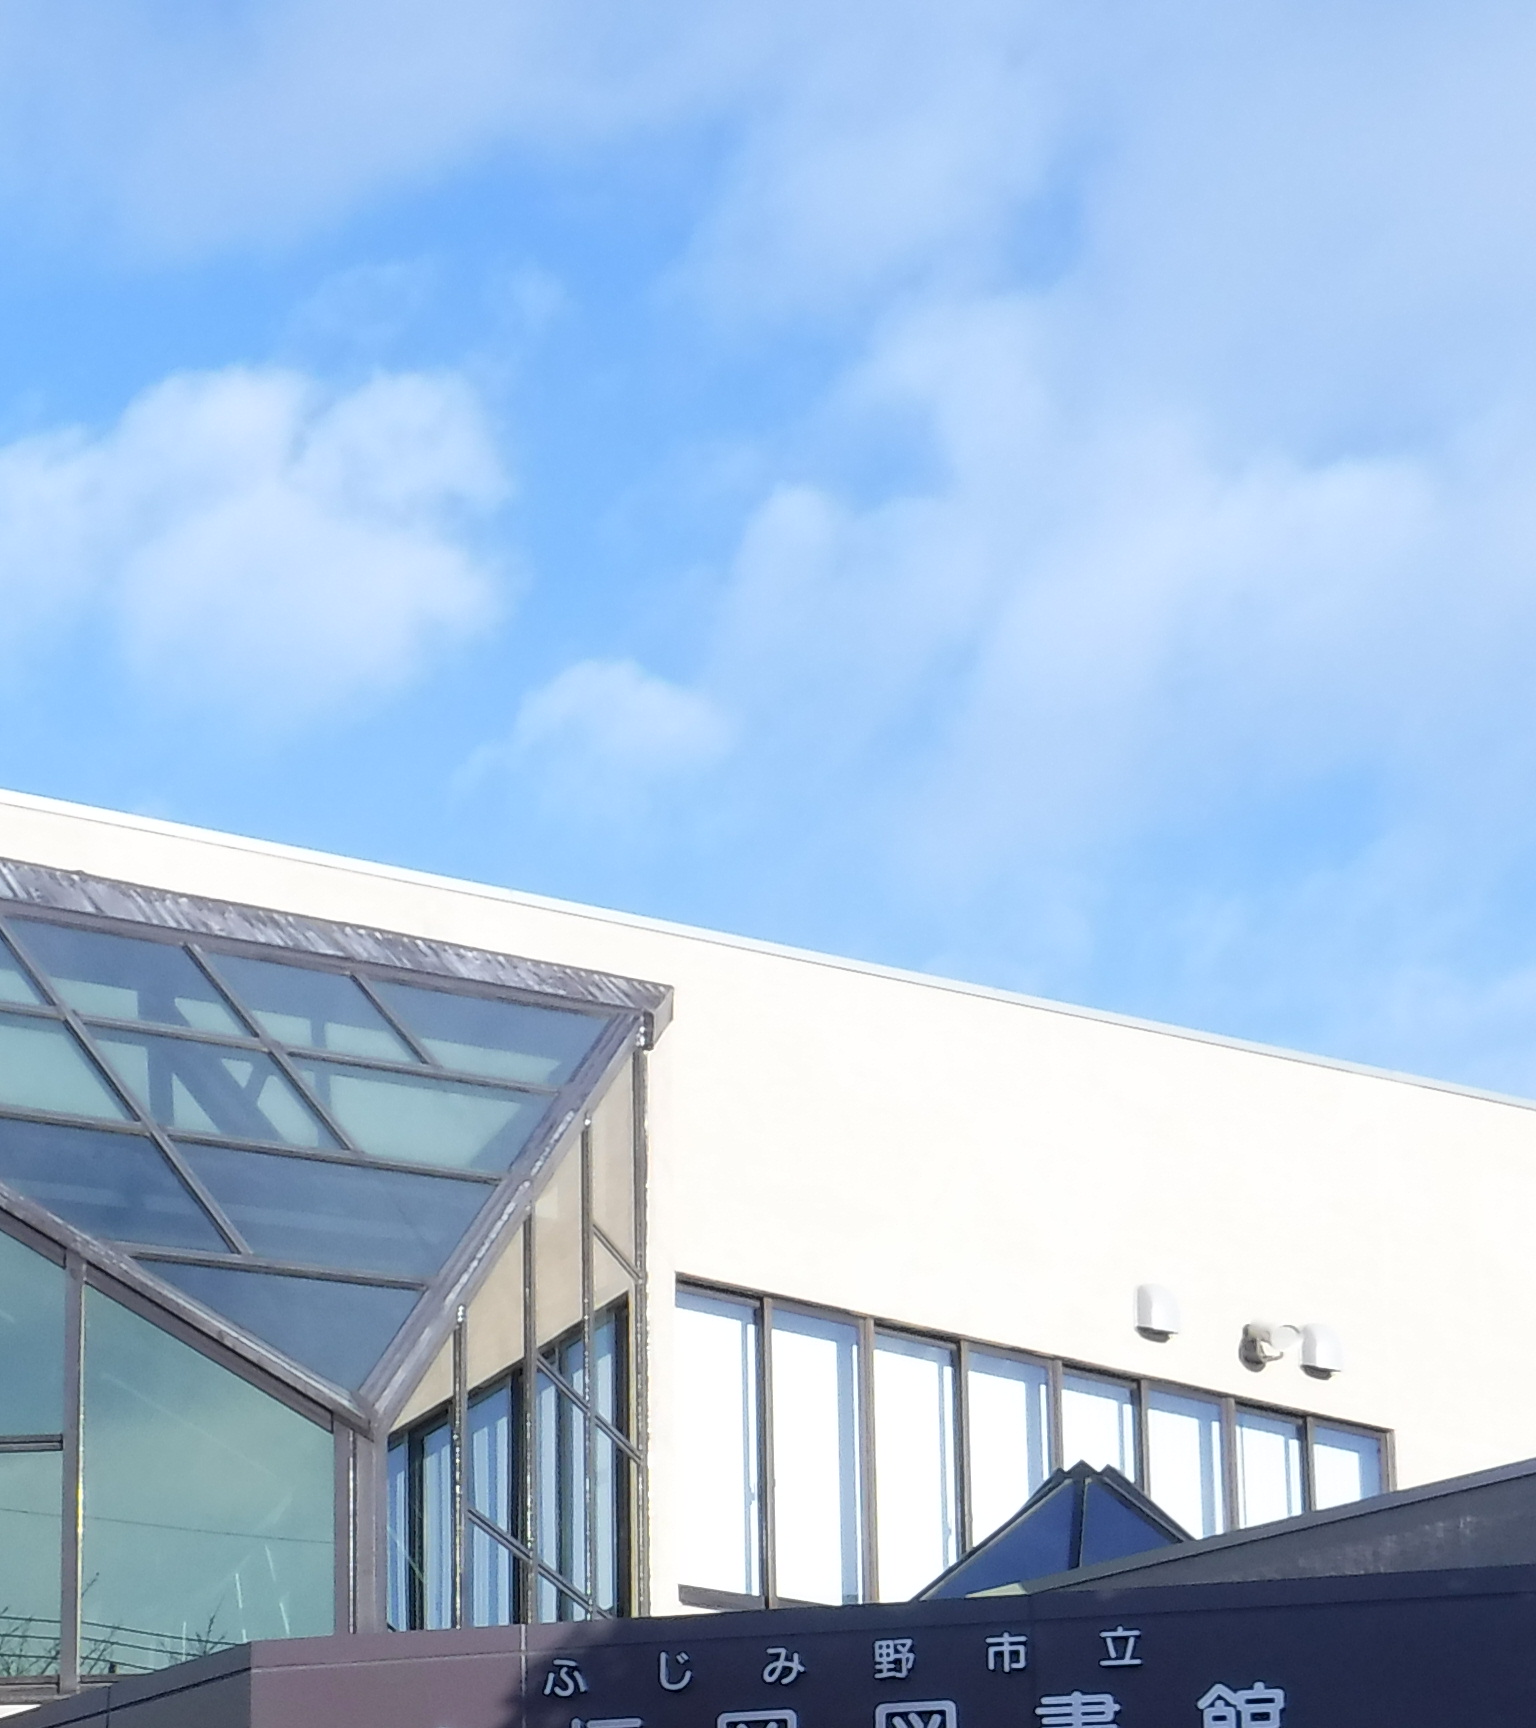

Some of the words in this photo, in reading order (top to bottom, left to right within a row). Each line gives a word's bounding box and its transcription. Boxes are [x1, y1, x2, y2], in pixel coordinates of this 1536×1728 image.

[543, 1626, 1144, 1698] ふじみ野市立
